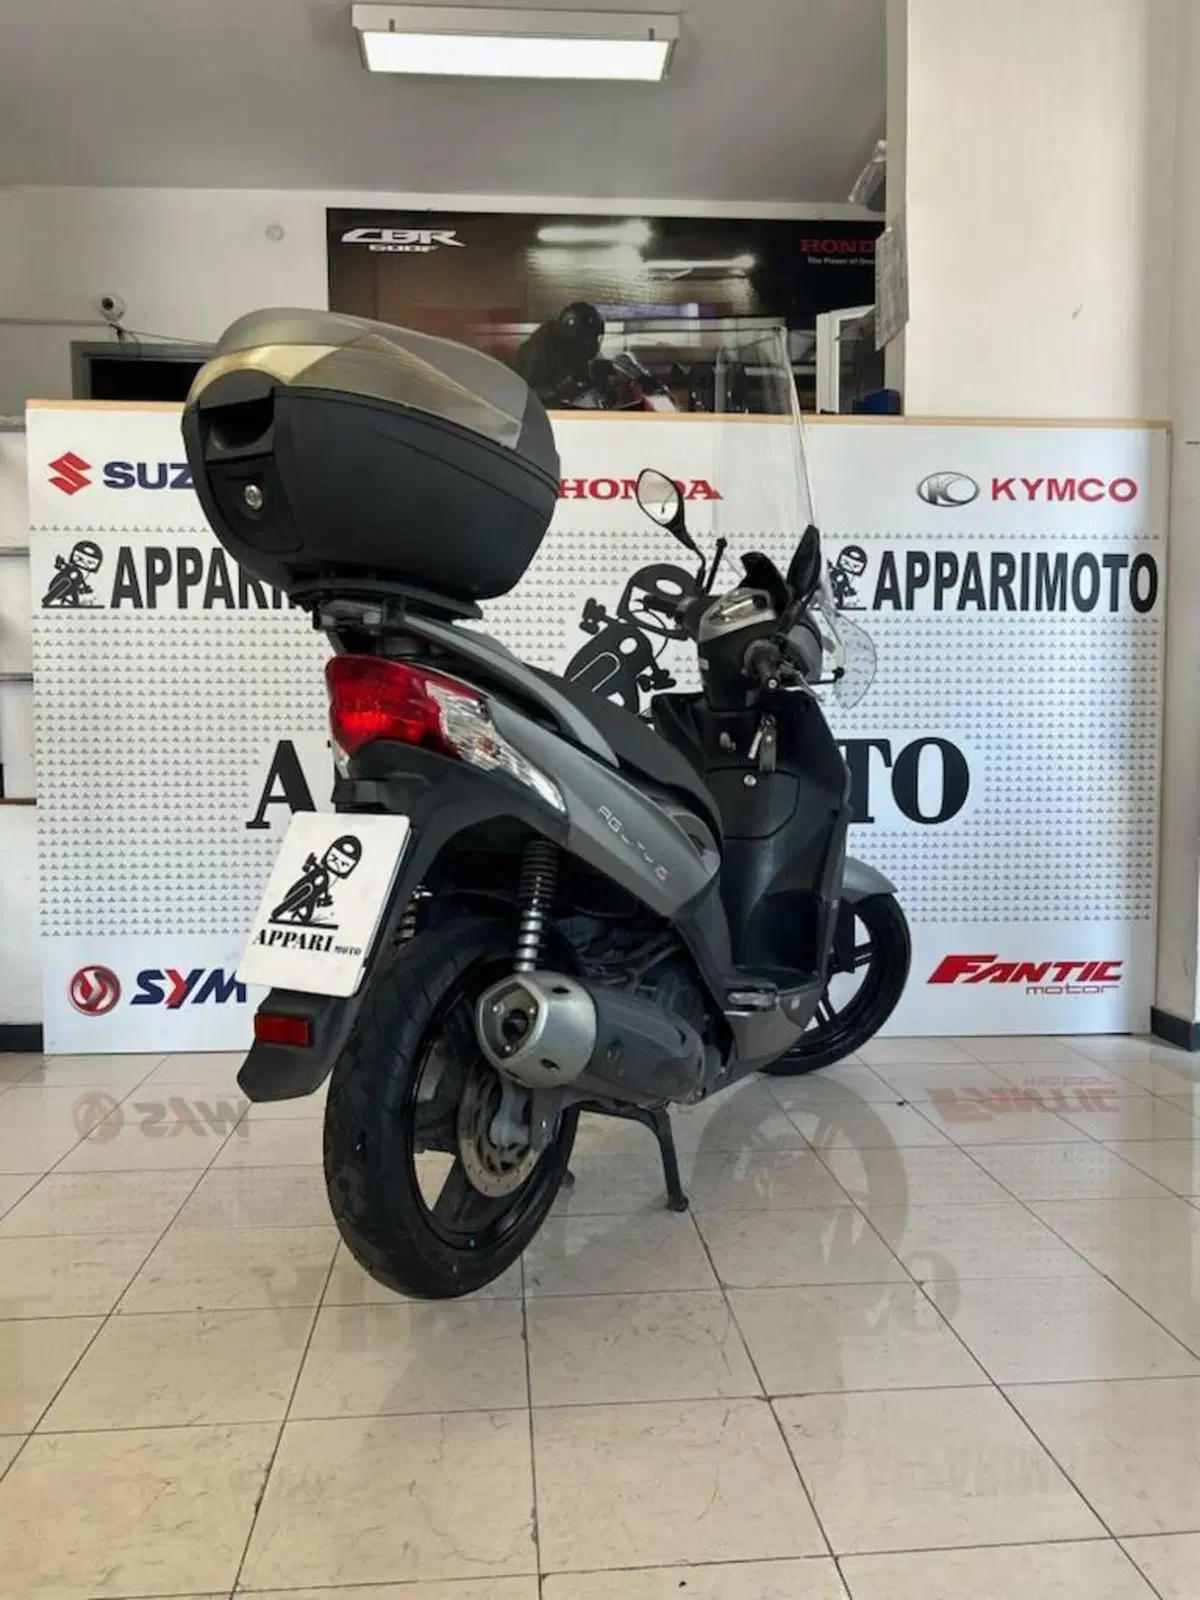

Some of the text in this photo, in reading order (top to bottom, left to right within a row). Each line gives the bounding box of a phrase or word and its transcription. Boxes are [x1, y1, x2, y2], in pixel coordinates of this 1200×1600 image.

[341, 228, 466, 247] CBR
[800, 239, 876, 253] HOND
[103, 461, 195, 490] SUZ
[991, 478, 1138, 501] KYMCO
[872, 551, 1158, 613] APPARIMOTO
[252, 928, 335, 953] APPARI
[926, 954, 1123, 984] FANTIC
[130, 968, 247, 1009] SYM
[1026, 984, 1119, 995] motor
